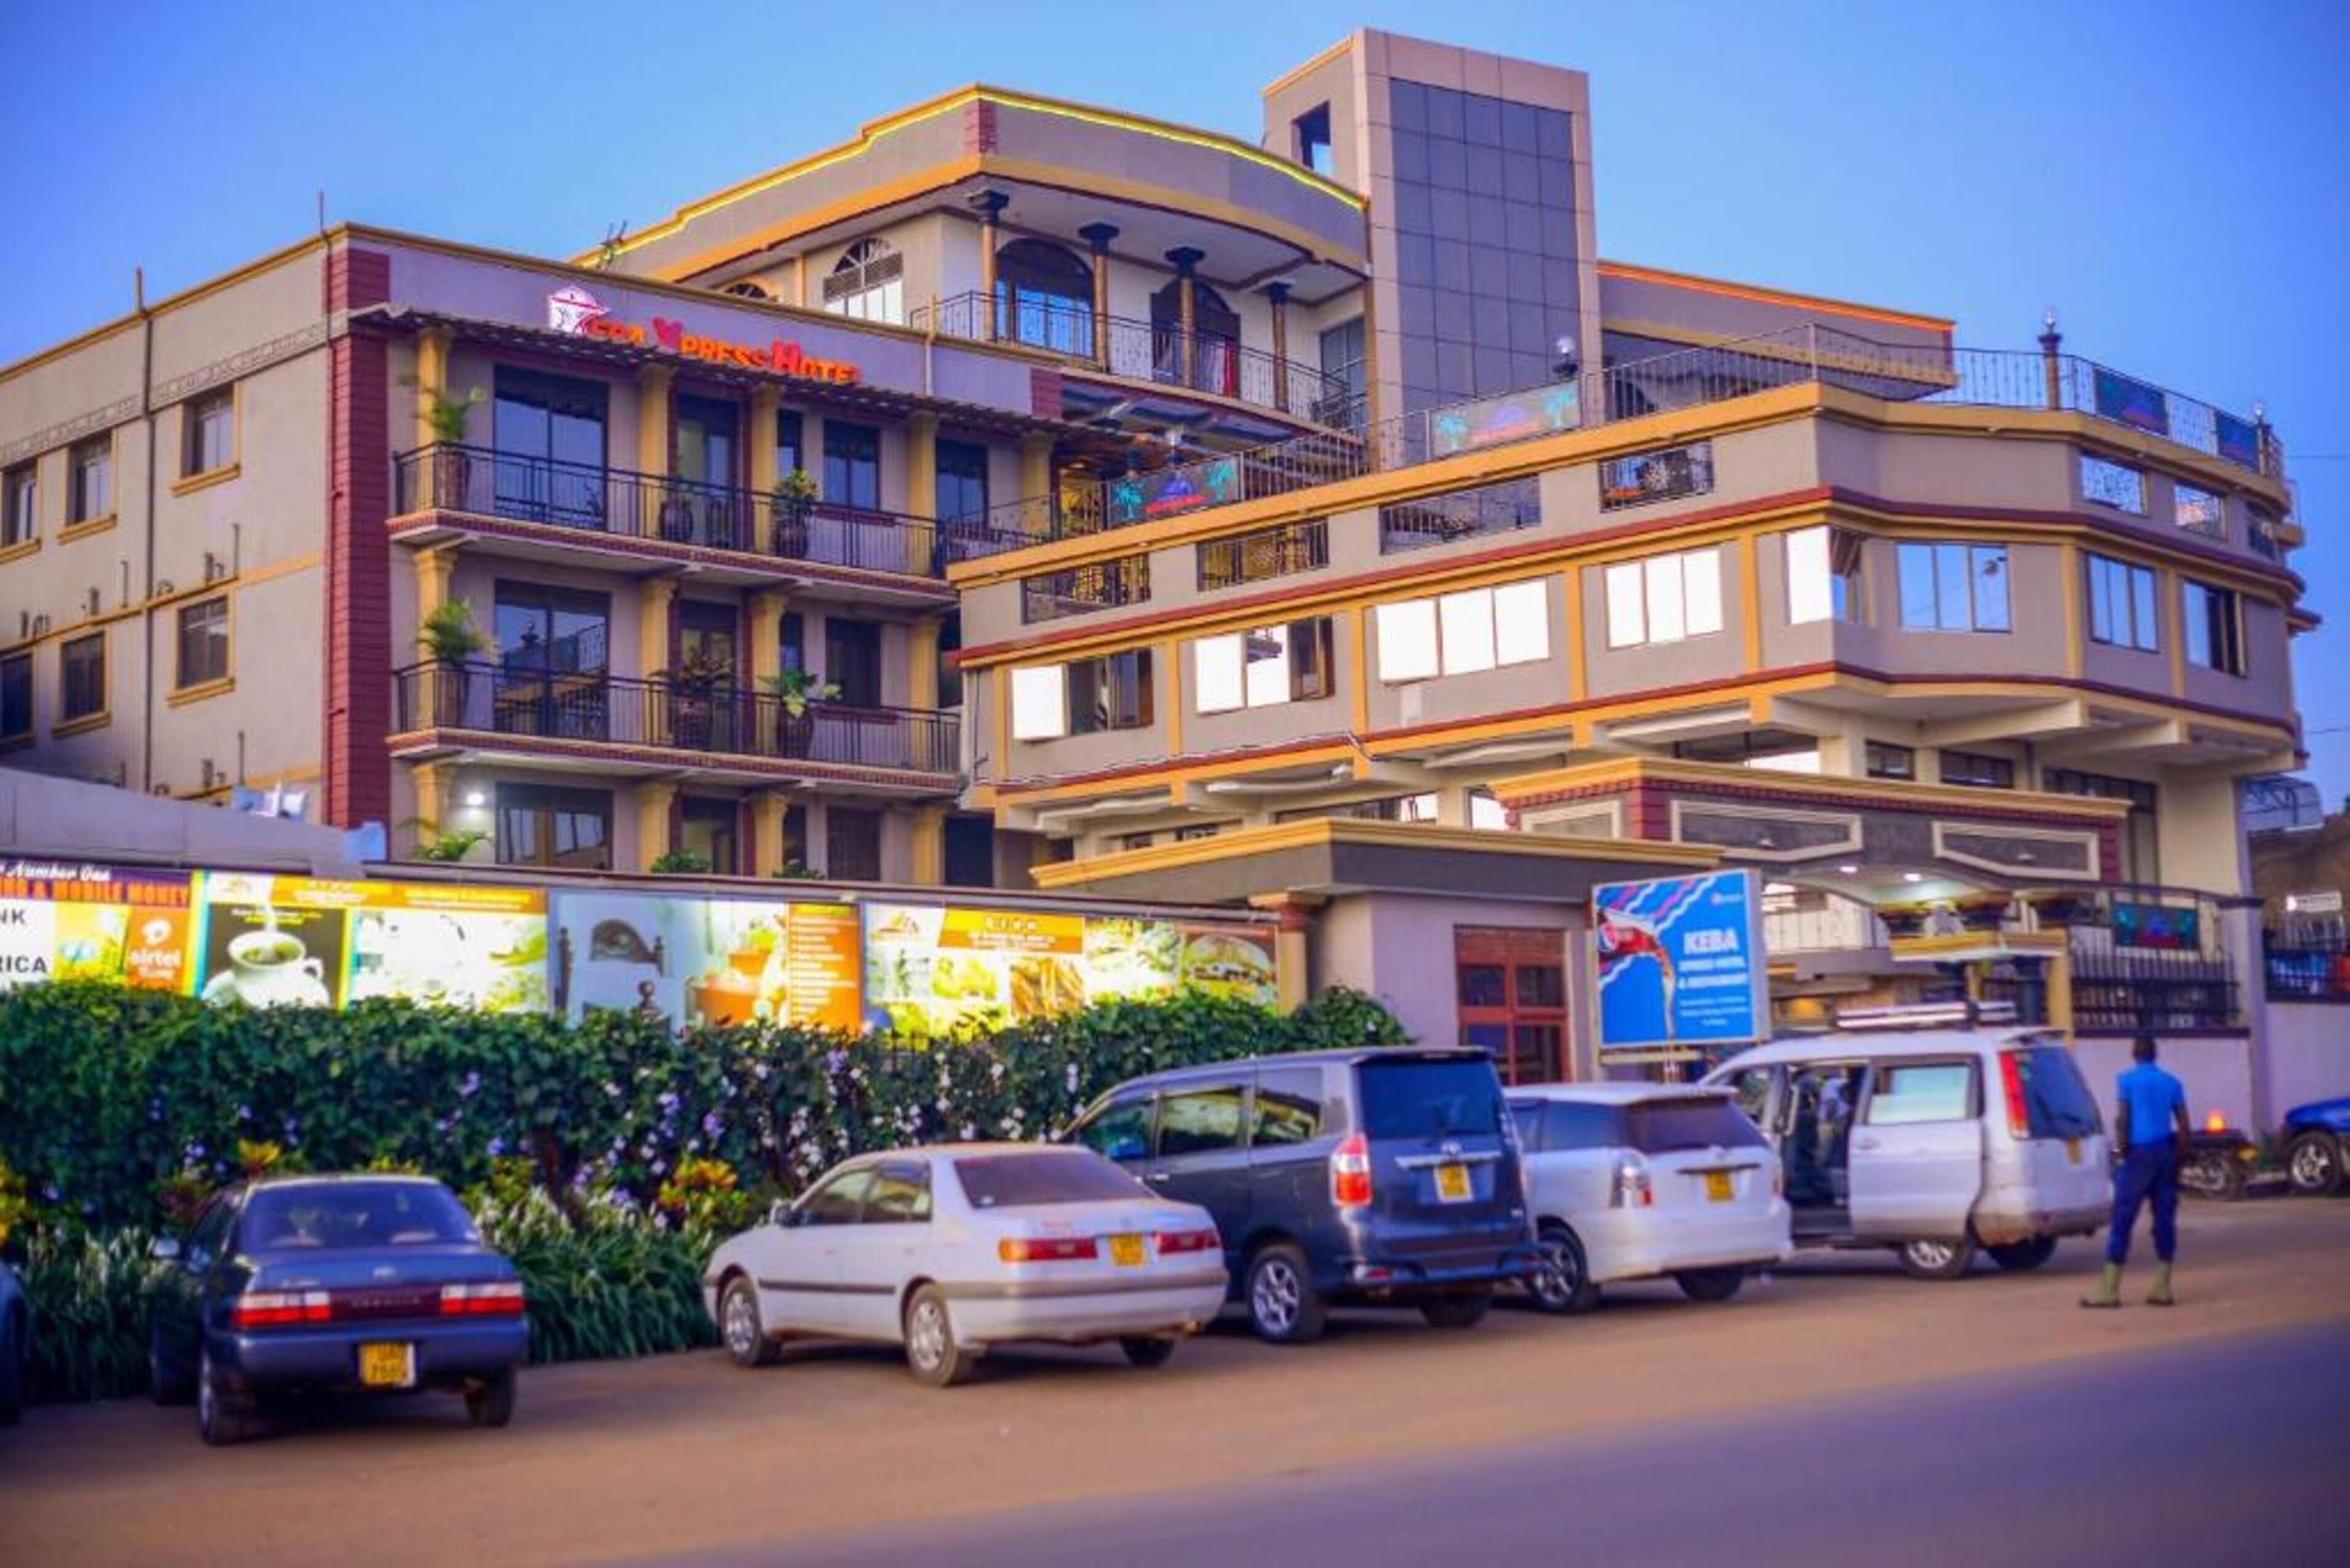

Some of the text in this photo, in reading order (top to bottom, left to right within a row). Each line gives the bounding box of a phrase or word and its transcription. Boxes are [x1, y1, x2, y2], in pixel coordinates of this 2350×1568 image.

[52, 879, 122, 903] MOBILE
[128, 882, 189, 907] MONEY
[1684, 927, 1740, 954] KEBA
[0, 955, 47, 973] ICA
[131, 948, 182, 968] airtel
